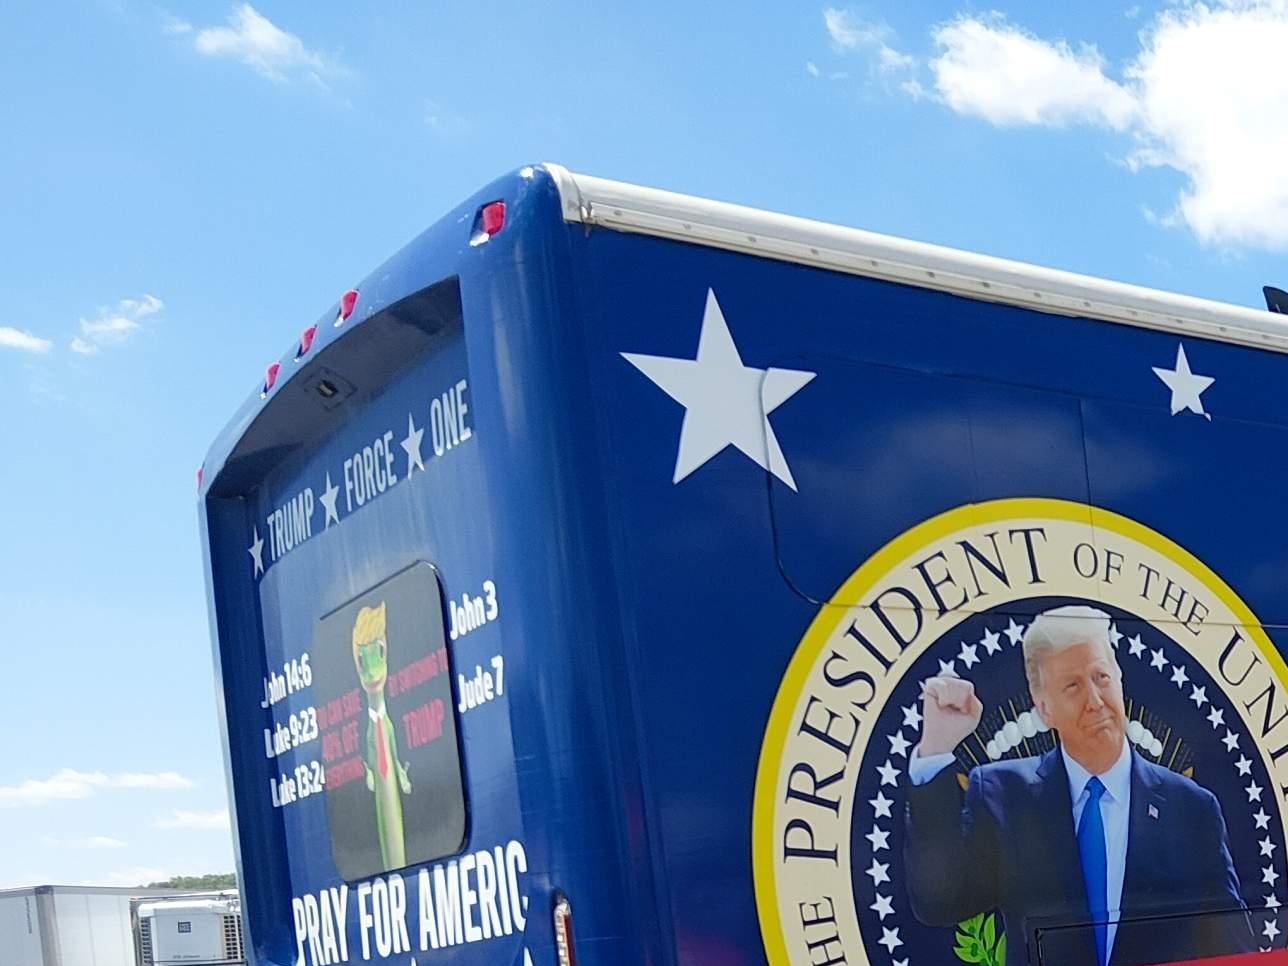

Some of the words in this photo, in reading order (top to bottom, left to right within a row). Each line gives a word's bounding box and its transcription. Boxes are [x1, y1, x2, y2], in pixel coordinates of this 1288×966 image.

[267, 487, 314, 561] TRUMP
[343, 430, 397, 512] FORCE
[430, 379, 472, 457] ONE
[450, 592, 486, 640] John
[483, 580, 498, 621] 3
[261, 671, 287, 708] John
[284, 653, 312, 694] 14:6
[458, 664, 494, 713] Jude
[783, 527, 1050, 870] PRESIDENT
[1072, 542, 1124, 583] OF
[1138, 562, 1210, 637] THE
[264, 723, 292, 758] Luke
[289, 707, 318, 747] 9:23
[270, 774, 297, 807] Luke
[358, 873, 411, 960] FOR
